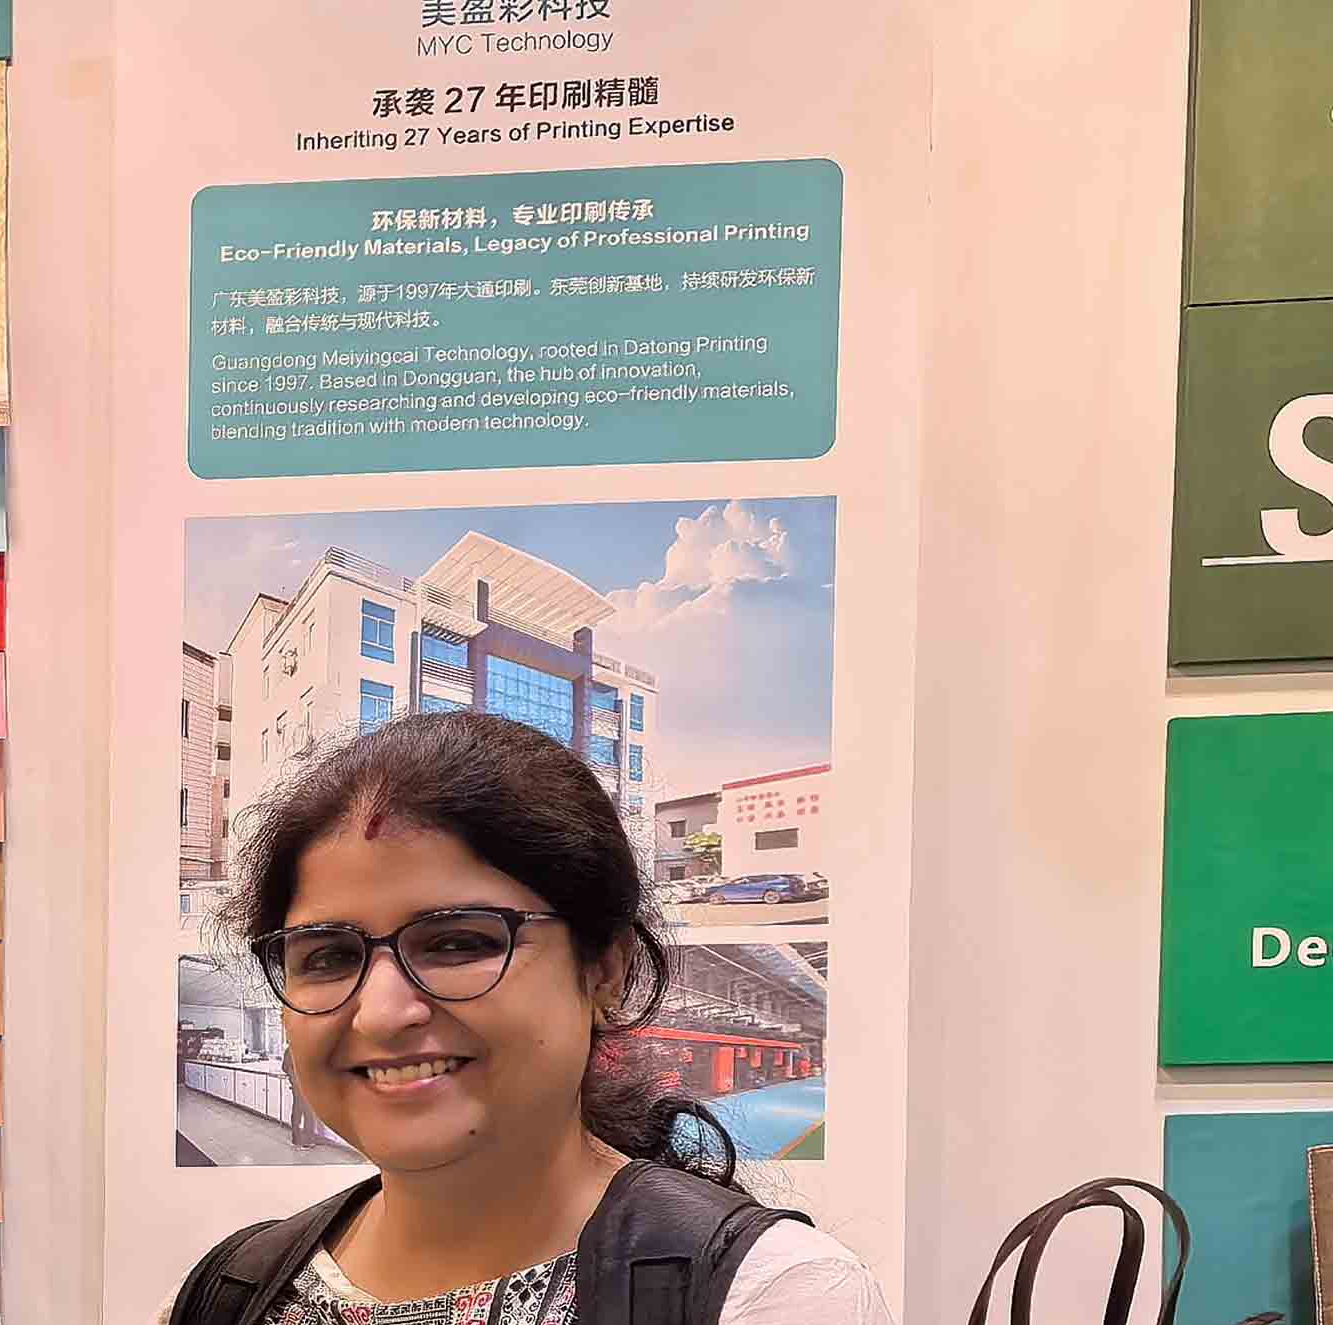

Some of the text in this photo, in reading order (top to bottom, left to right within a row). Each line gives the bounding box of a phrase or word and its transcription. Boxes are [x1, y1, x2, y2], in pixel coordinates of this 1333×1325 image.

[421, 0, 611, 28] 美盈彩科技
[417, 30, 613, 56] MYC Technology
[372, 75, 659, 118] 承袭 27 年印刷精髓
[296, 113, 735, 151] Inheriting 27 Years of Printing Expertise
[364, 235, 469, 256] Materials,
[474, 234, 552, 254] Legacy
[557, 230, 580, 249] of
[584, 225, 718, 247] Professional
[724, 221, 810, 242] Printing
[212, 335, 769, 372] Guangdong Meiyingcai Technology, rooted in Datong Printing
[211, 360, 702, 394] since 1997. Based in Dongguan, the hub of innovation,
[211, 398, 325, 417] continuously
[328, 392, 437, 412] researching
[441, 391, 476, 408] and
[482, 388, 580, 408] developing
[703, 380, 795, 400] materials,
[211, 411, 590, 441] blending tradition with modern technology.
